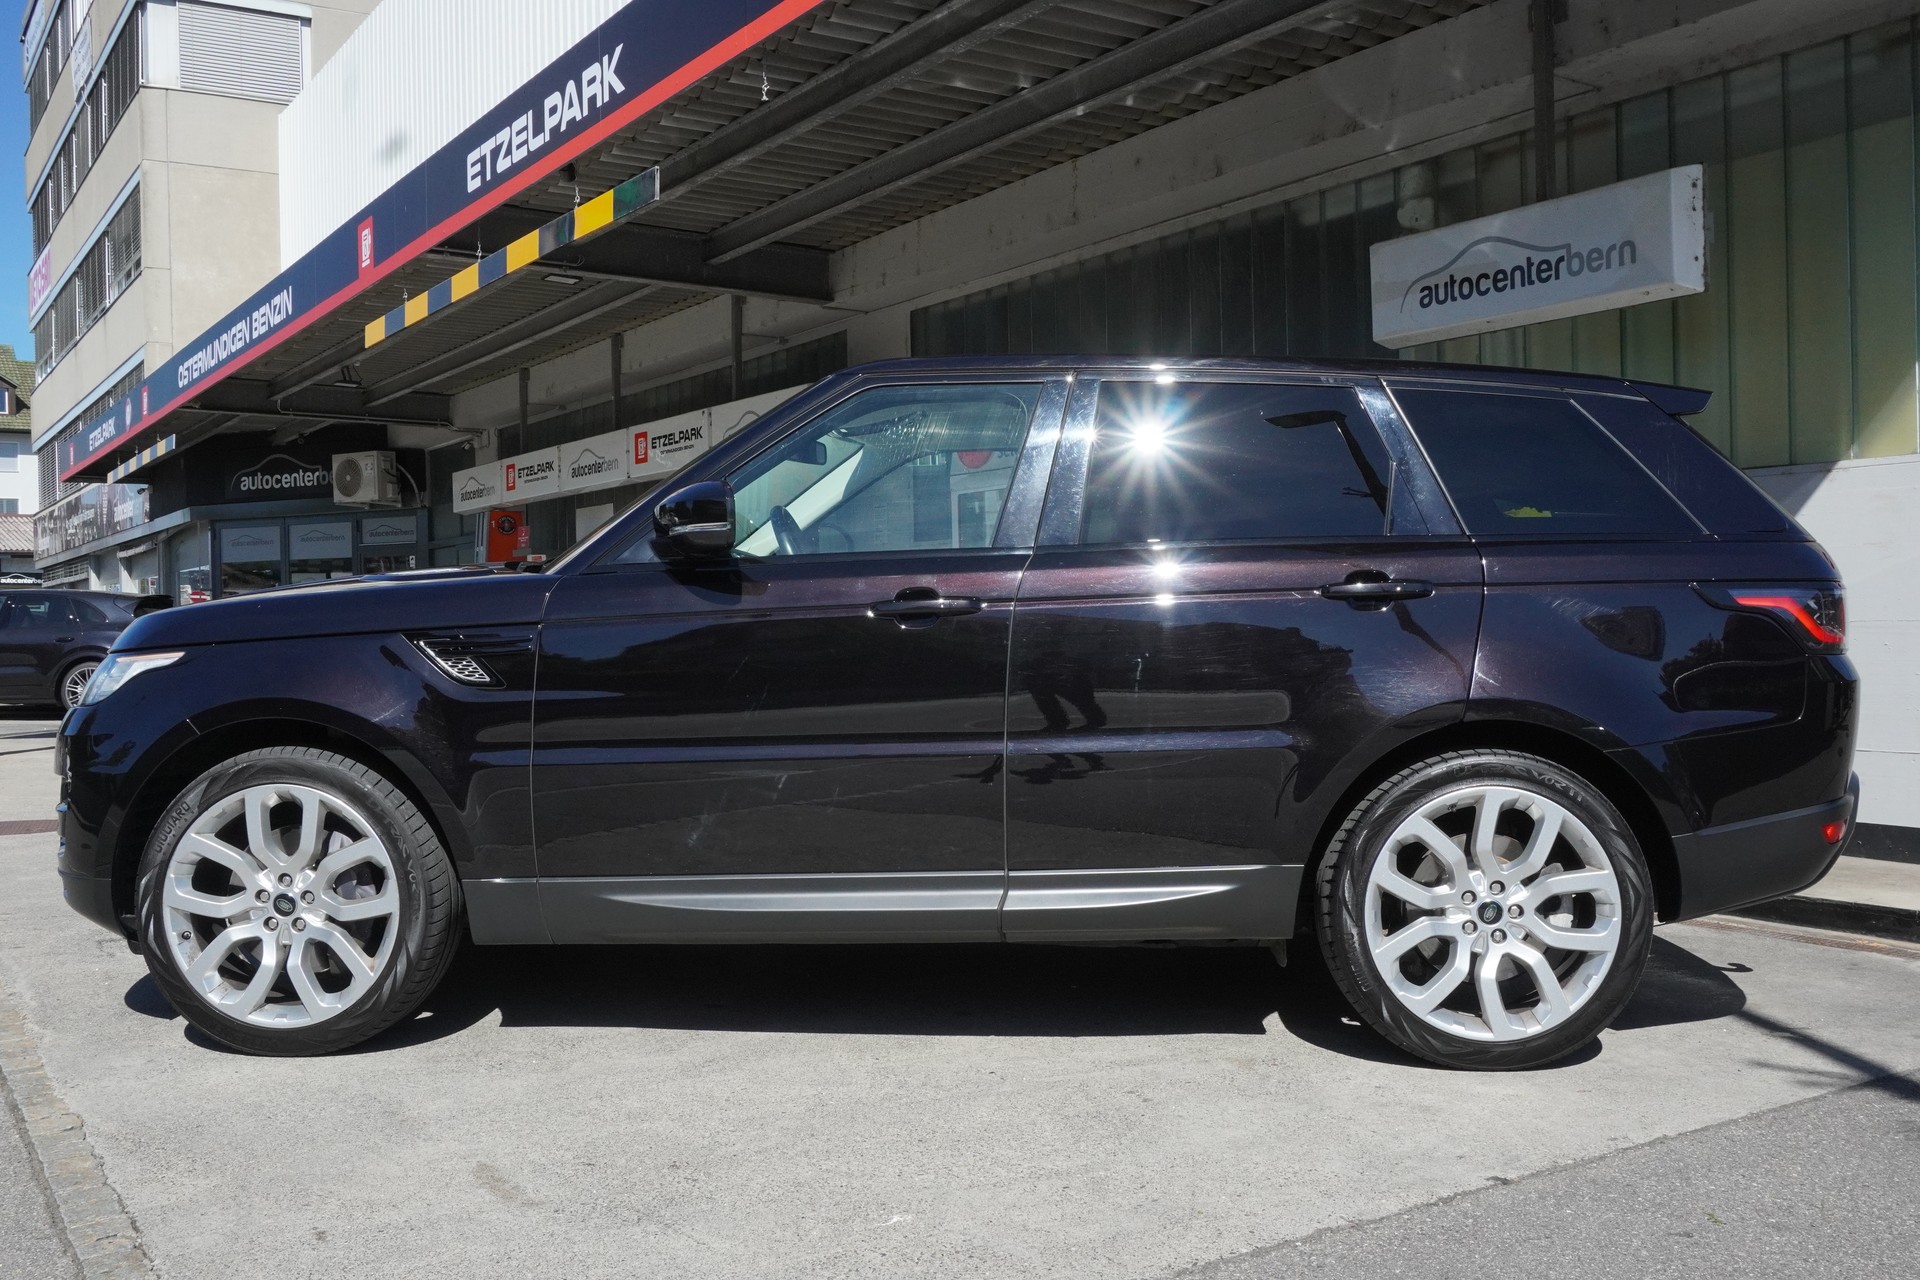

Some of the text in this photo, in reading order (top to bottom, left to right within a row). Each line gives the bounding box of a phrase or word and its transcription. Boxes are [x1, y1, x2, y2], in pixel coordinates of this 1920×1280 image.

[466, 43, 626, 194] ETZELPARK
[1418, 239, 1637, 309] autocenterbern
[177, 285, 293, 389] OSTERMUNDIGEN BENZIN
[89, 416, 116, 452] ETZELPARK
[651, 426, 703, 450] ETZELPARK
[240, 465, 333, 491] autocenterbe
[517, 460, 555, 479] ETZELPARK
[570, 456, 620, 479] autocenterbern
